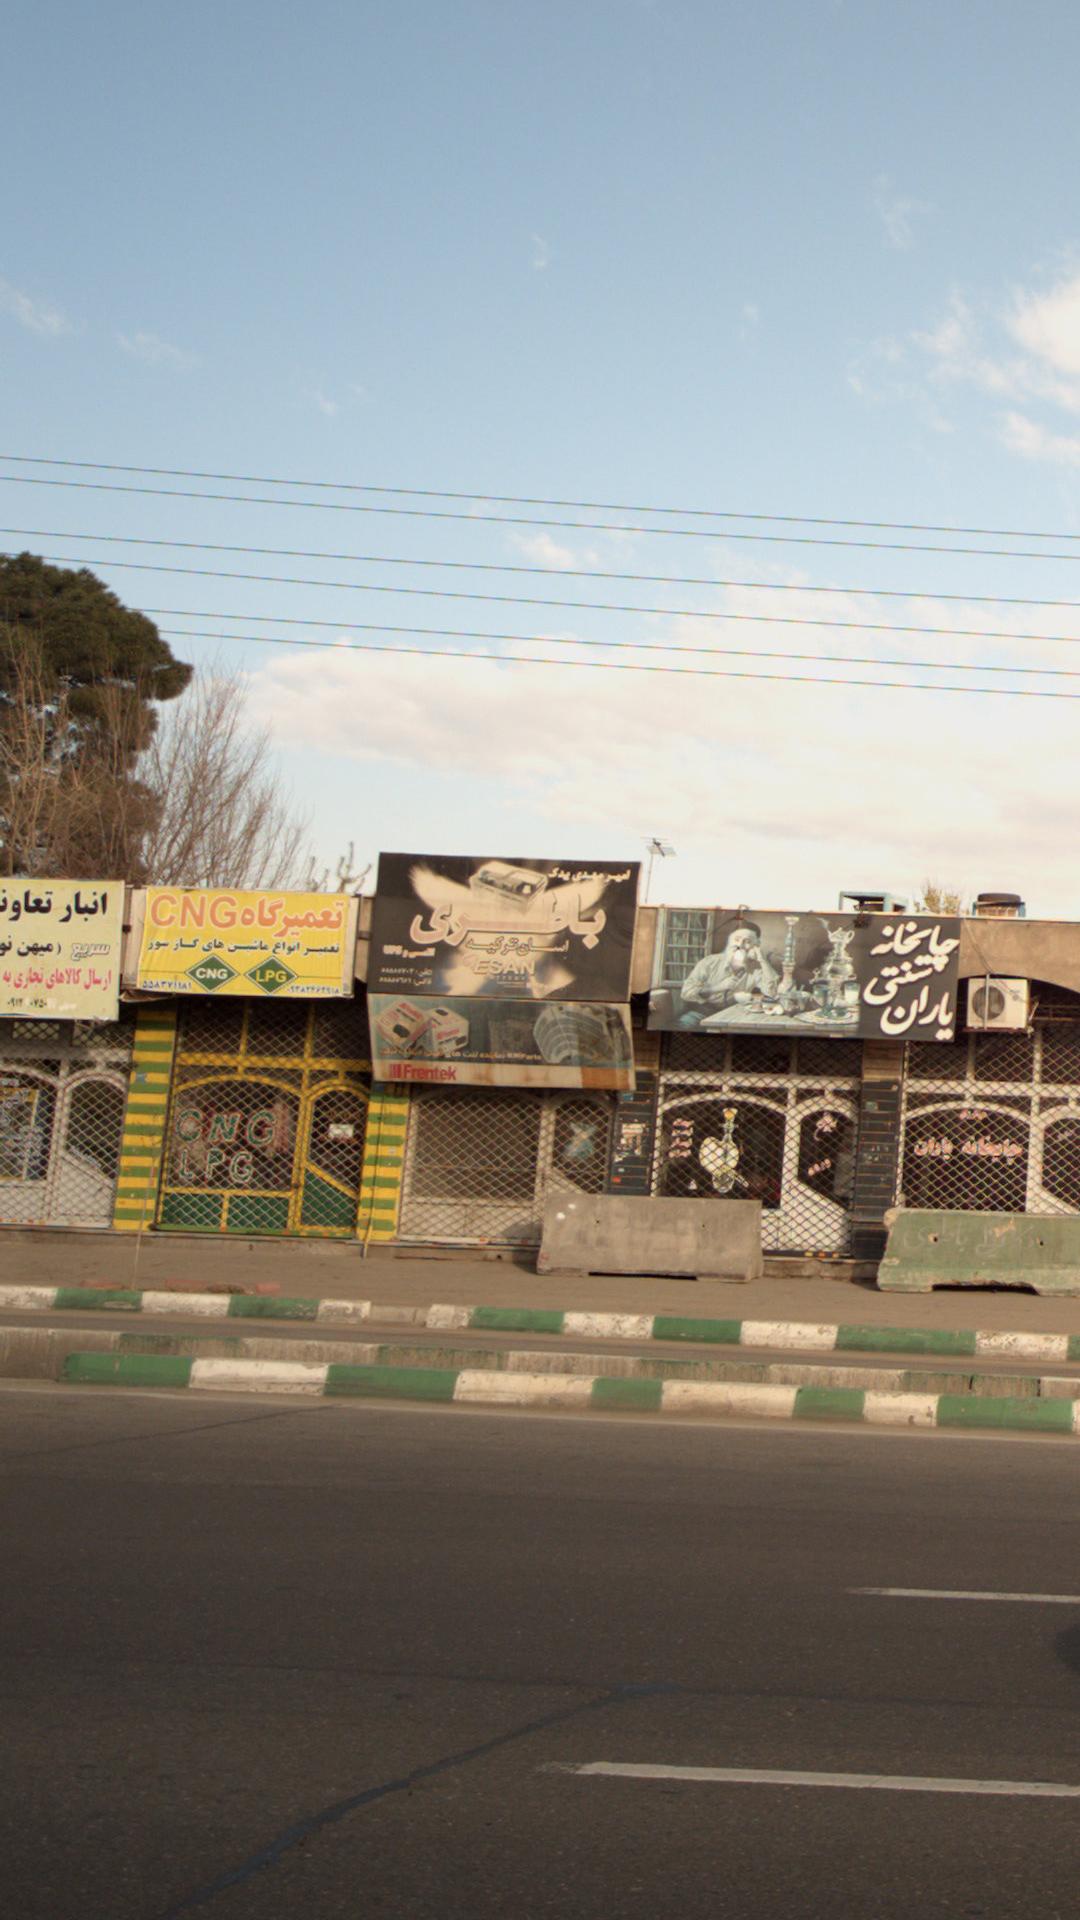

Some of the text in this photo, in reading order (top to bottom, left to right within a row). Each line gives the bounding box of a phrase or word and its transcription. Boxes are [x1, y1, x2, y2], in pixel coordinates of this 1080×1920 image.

[0, 888, 108, 922] انبار تعاون
[150, 893, 344, 938] تعمیرگاه CNG
[409, 888, 608, 950] باطری
[201, 937, 225, 952] های
[271, 940, 300, 955] انواع
[870, 920, 961, 973] چایخانه
[45, 967, 82, 990] کالاهای
[83, 968, 113, 992] ارسال
[195, 966, 229, 981] CNG
[255, 968, 289, 983] LPG
[473, 959, 537, 977] ESAN
[879, 984, 954, 1041] یاران
[402, 1063, 457, 1081] Frentek
[174, 1107, 277, 1148] CNG
[178, 1148, 254, 1183] LPG
